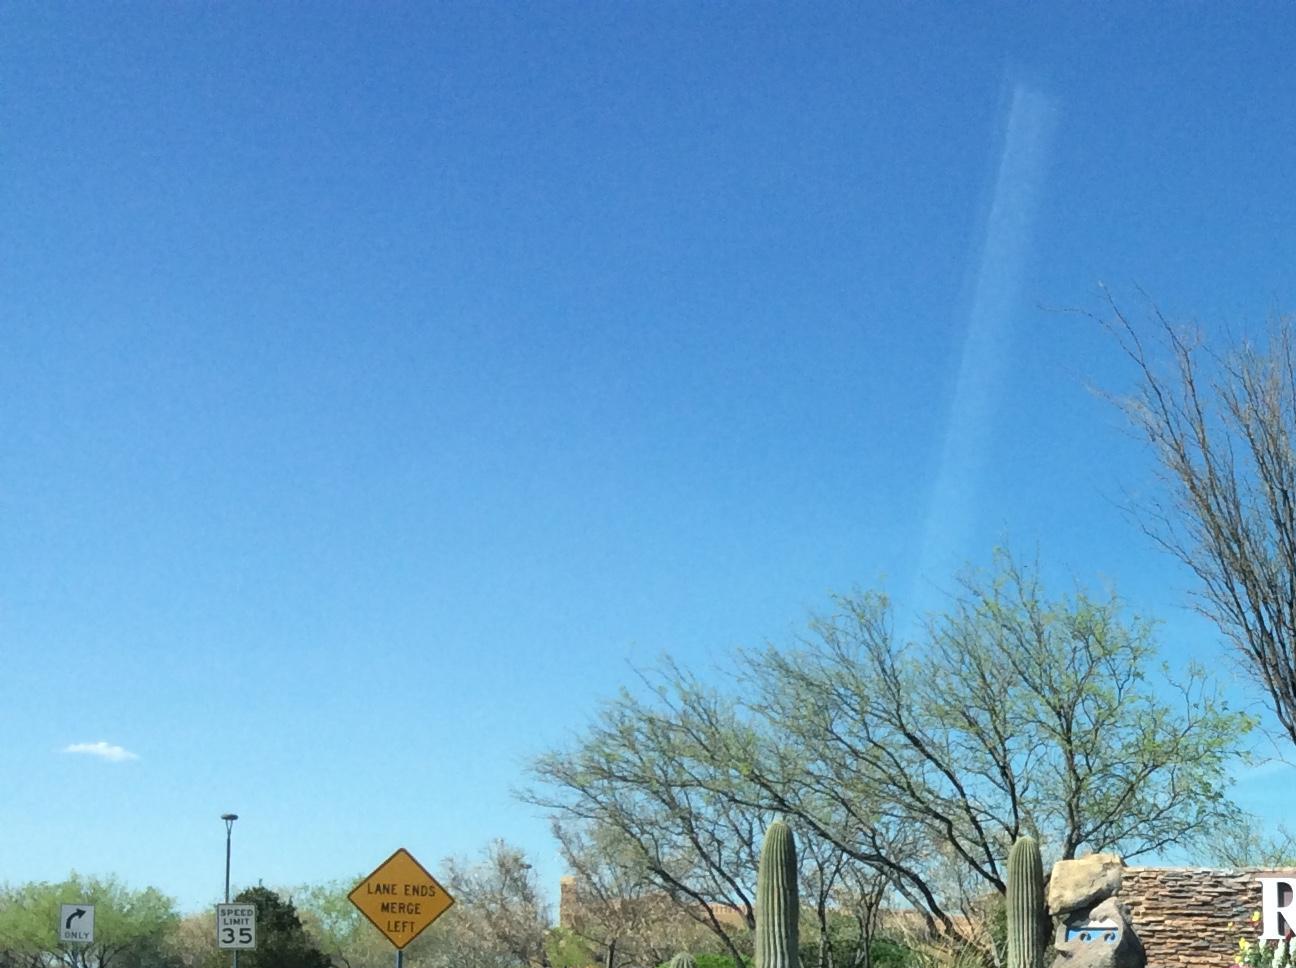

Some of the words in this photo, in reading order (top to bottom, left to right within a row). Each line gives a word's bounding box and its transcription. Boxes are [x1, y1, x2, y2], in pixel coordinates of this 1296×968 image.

[367, 883, 397, 896] LANE
[404, 885, 436, 897] ENDS
[220, 909, 254, 917] SPEED
[380, 902, 421, 915] MERGE
[223, 918, 249, 926] LIMIT
[386, 920, 416, 933] LEFT
[64, 931, 90, 940] ONLY
[222, 927, 253, 944] 35
